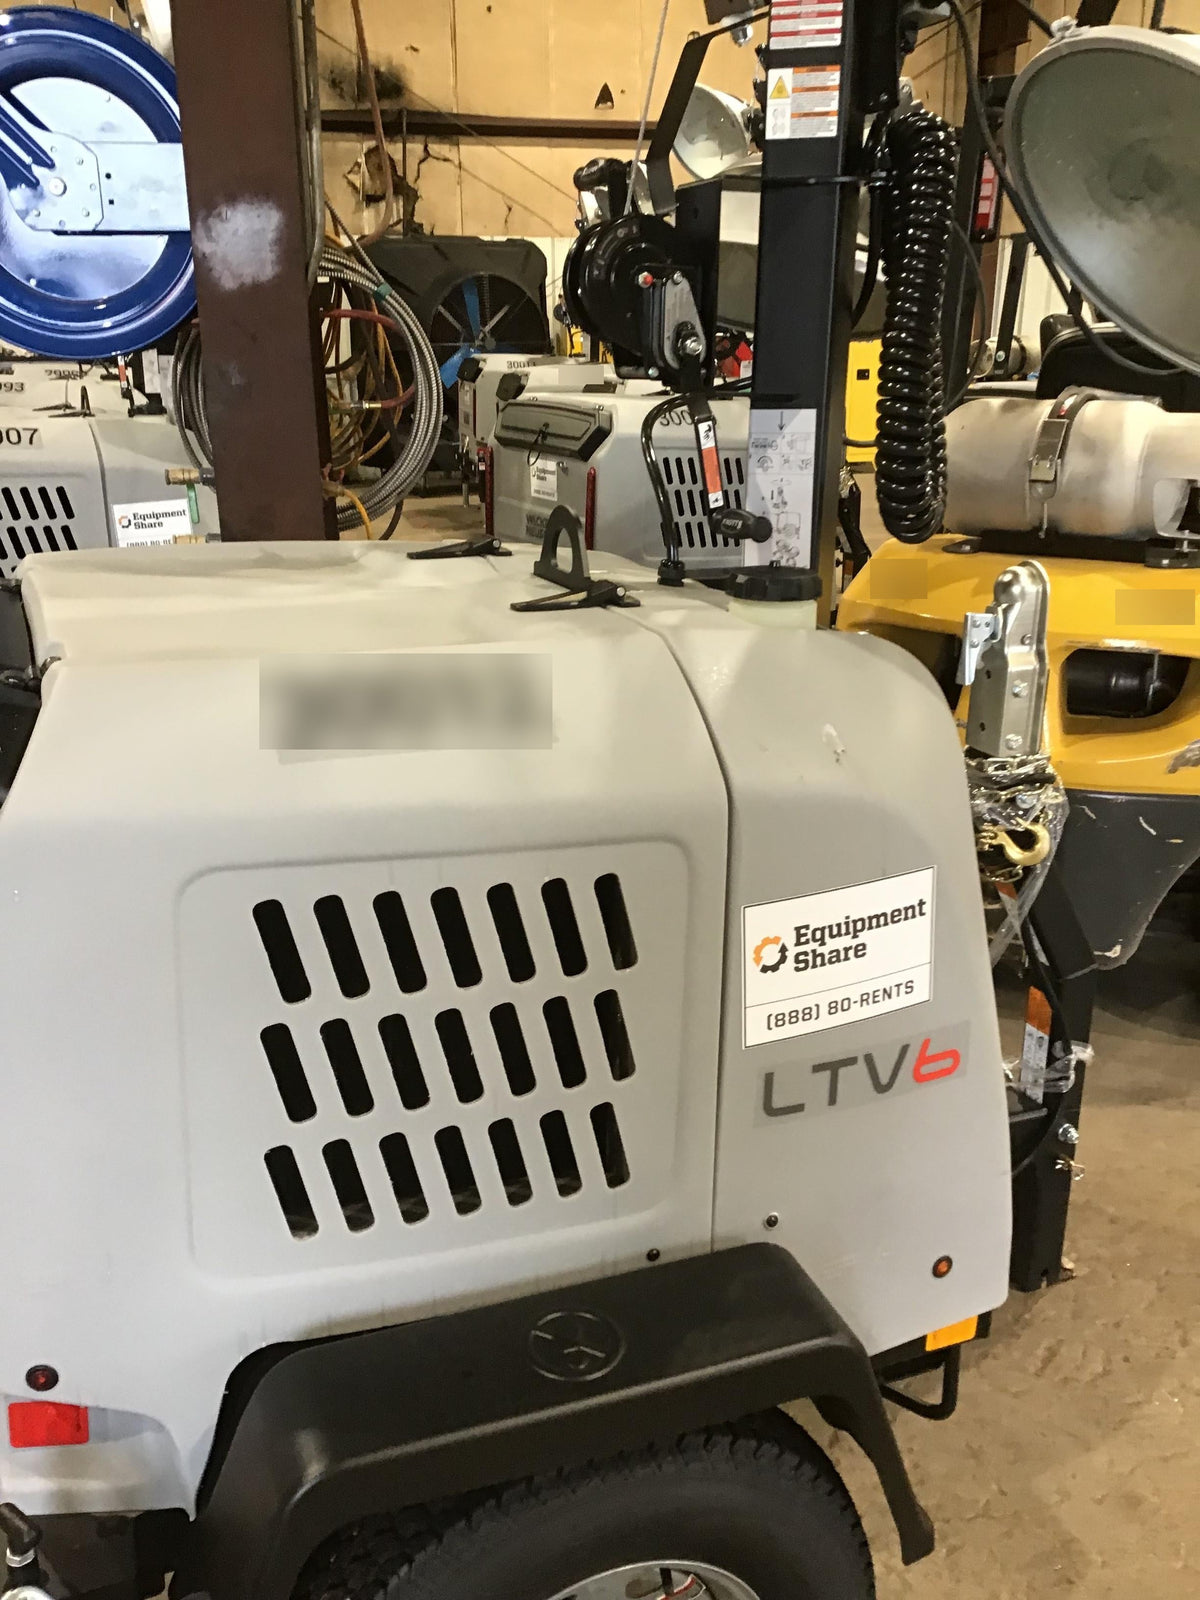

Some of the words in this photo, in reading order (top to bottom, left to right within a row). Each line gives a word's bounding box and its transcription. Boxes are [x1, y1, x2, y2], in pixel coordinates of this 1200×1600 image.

[0, 382, 24, 392] 93
[0, 427, 39, 446] 07
[132, 508, 187, 521] Equipment
[133, 521, 164, 530] Share
[793, 898, 927, 947] Equipment
[793, 942, 868, 973] Share
[766, 1003, 821, 1031] (888)
[827, 979, 915, 1016] 80-RENTS
[762, 1037, 961, 1118] LTV6
